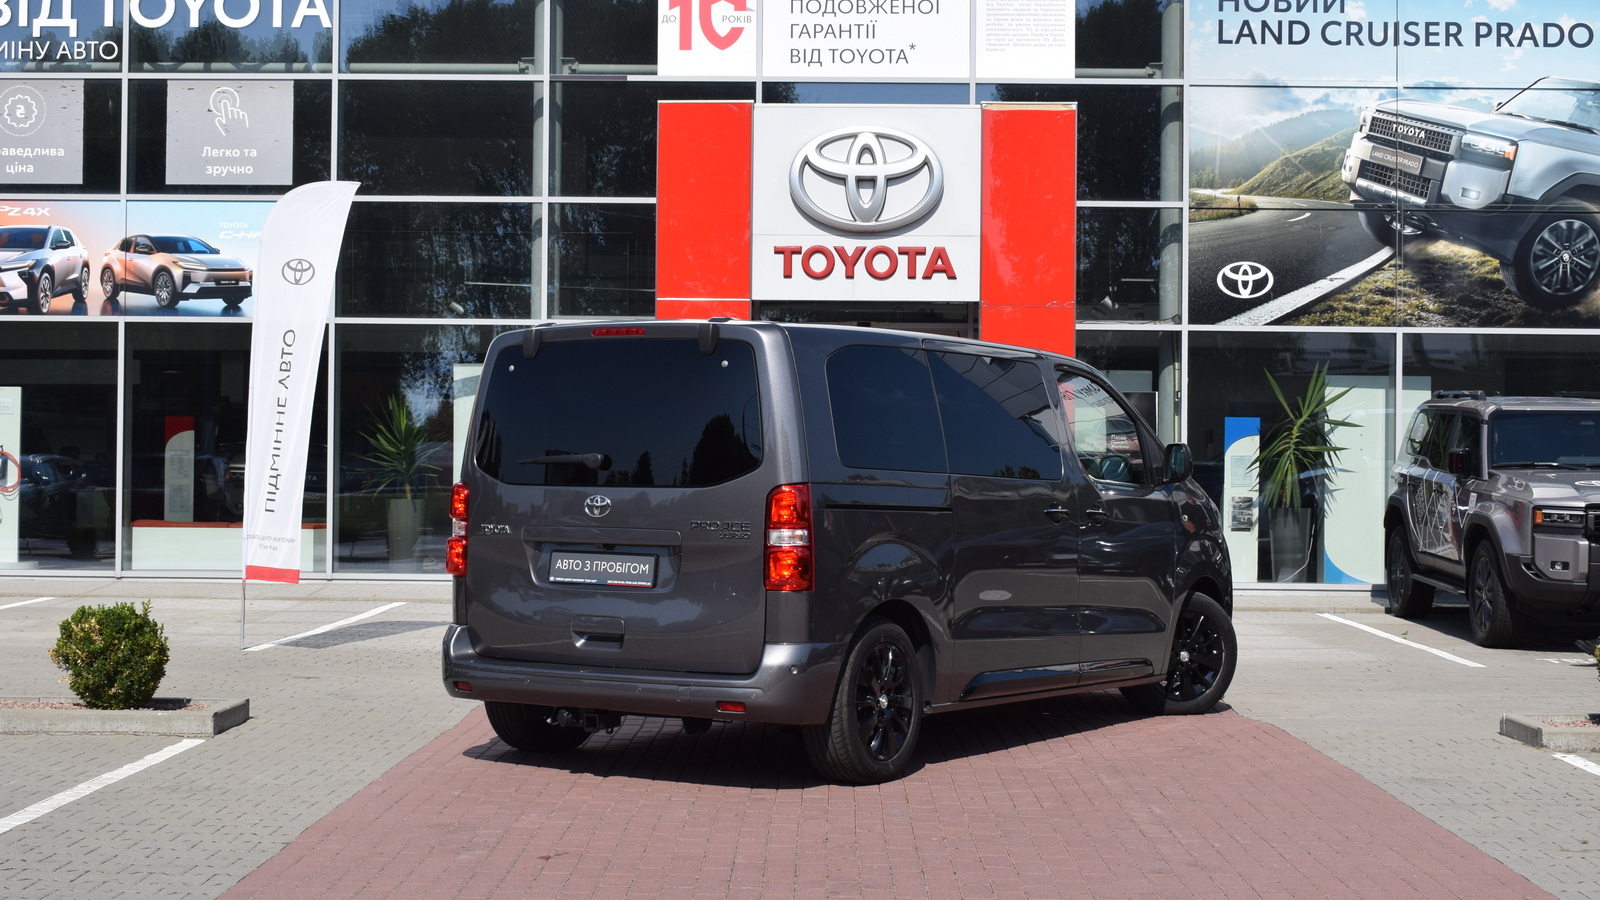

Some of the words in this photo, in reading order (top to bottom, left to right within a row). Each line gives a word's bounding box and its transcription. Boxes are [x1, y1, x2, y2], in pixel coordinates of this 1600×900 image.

[661, 15, 677, 24] ДО
[722, 15, 752, 23] РОКІВ
[790, 20, 878, 39] ГАРАНТІЇ
[1218, 19, 1310, 45] LAND
[1320, 20, 1464, 47] CRUISER
[1474, 21, 1595, 48] PRADO
[56, 41, 119, 60] АВТО
[790, 49, 823, 67] ВІД
[1392, 124, 1425, 139] TOYOTA
[0, 147, 65, 158] аведлива
[202, 147, 241, 157] Легко
[243, 149, 257, 157] та
[6, 162, 34, 174] ціна
[206, 166, 253, 176] зручно
[773, 245, 957, 280] TOYOTA
[264, 396, 288, 513] ПІДМІННЕ
[278, 329, 296, 389] АВТО
[555, 559, 582, 571] АВТО
[584, 561, 591, 571] З
[593, 561, 649, 574] ПРОБІГОМ
